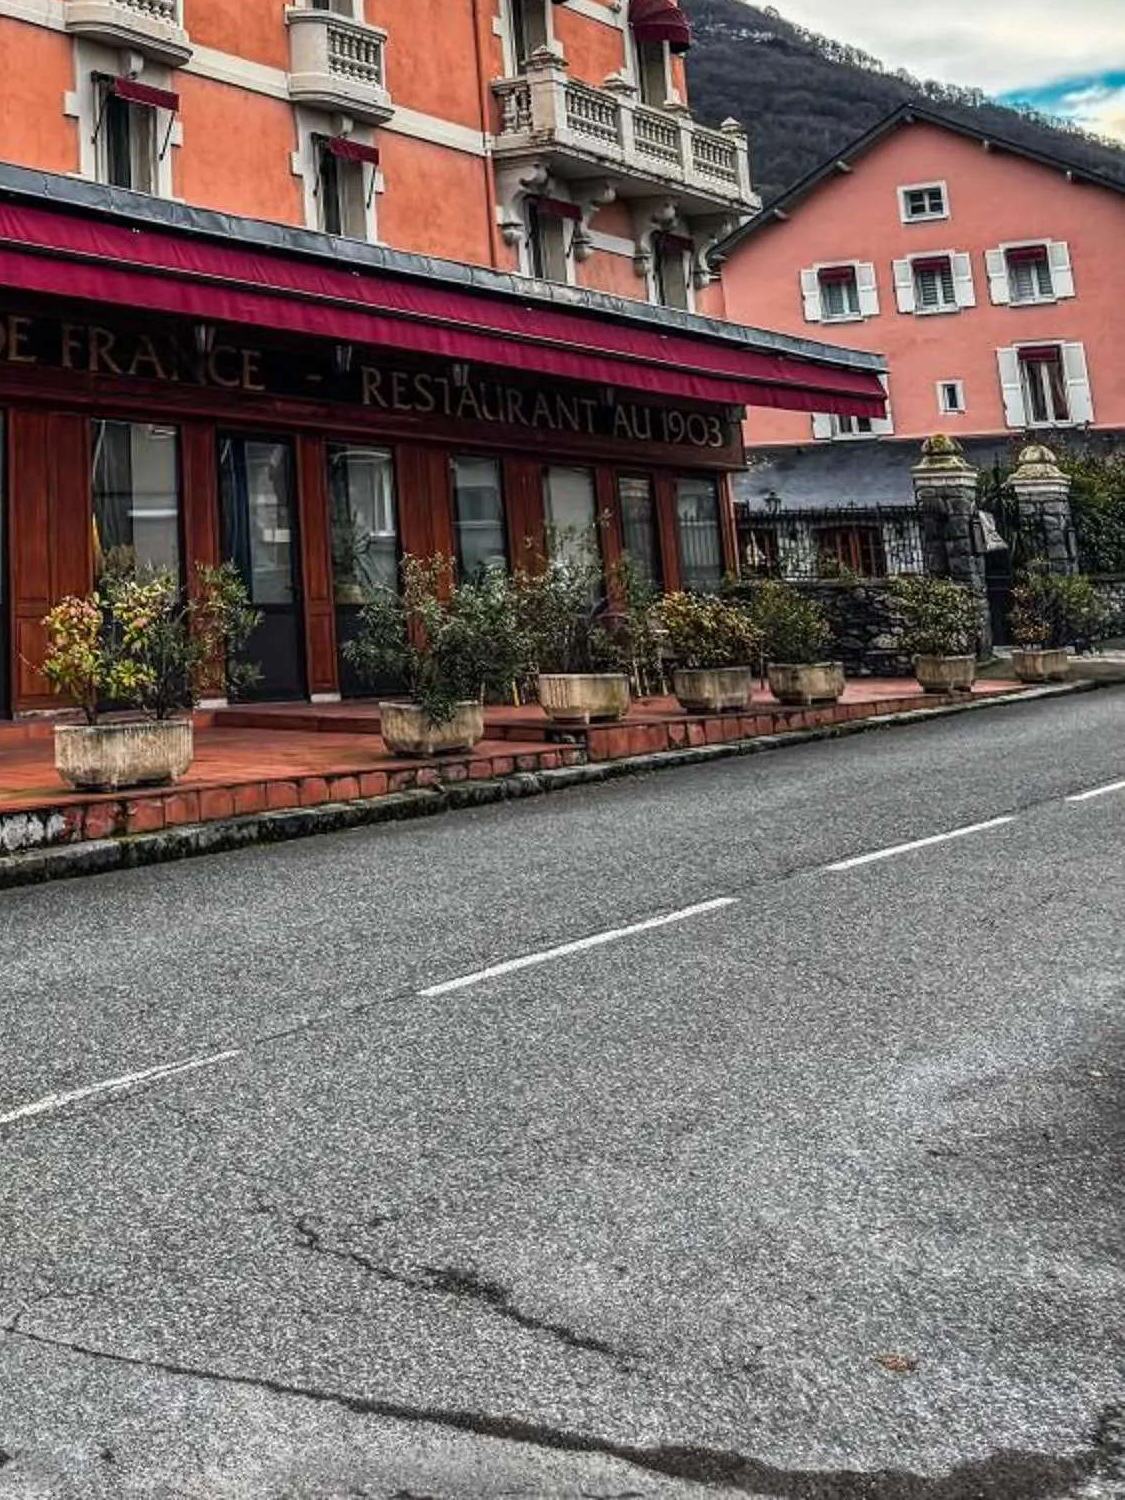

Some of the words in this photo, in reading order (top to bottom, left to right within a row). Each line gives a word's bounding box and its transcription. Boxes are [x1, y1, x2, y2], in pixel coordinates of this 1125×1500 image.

[61, 322, 266, 392] FRANCE
[360, 365, 600, 435] RESTAURANT
[611, 403, 653, 441] AU
[660, 410, 724, 449] 1903
